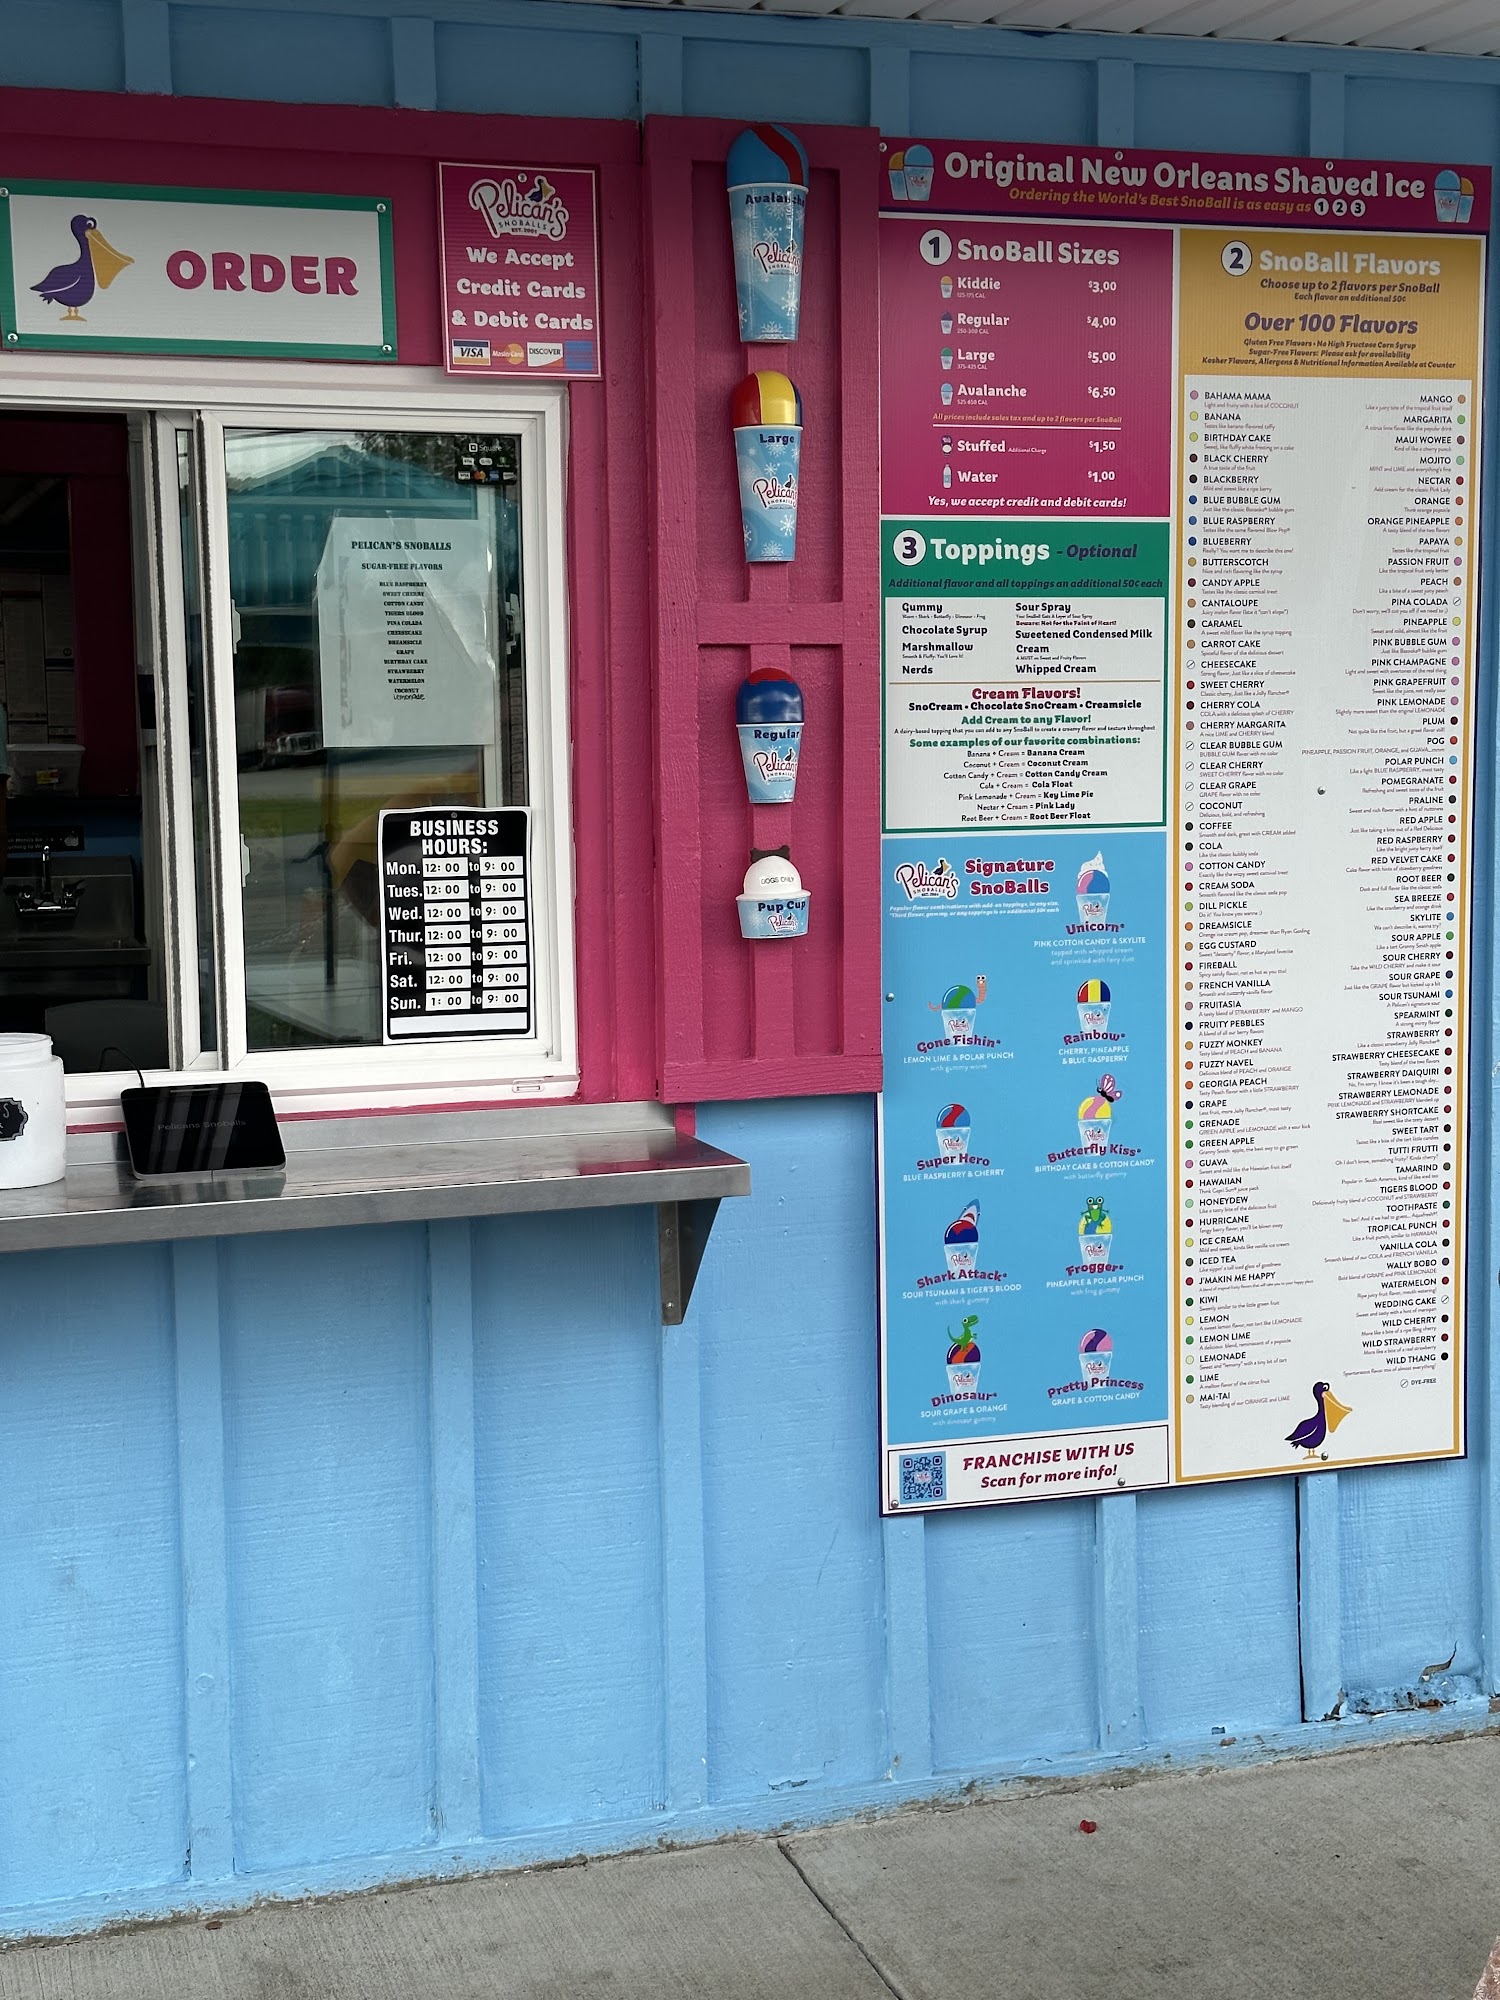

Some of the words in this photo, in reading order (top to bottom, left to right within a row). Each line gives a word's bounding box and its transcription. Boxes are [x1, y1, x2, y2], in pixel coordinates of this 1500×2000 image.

[945, 152, 1074, 187] Original
[1081, 158, 1146, 186] New
[1154, 162, 1268, 192] Orleans
[1274, 167, 1378, 197] Shaved
[1385, 173, 1425, 198] Ice
[1009, 188, 1070, 204] Ordering
[1073, 190, 1095, 202] the
[1098, 192, 1147, 205] World's
[1150, 194, 1178, 206] Best
[1180, 196, 1231, 208] SnoBall
[1233, 201, 1244, 209] is
[1247, 201, 1261, 210] as
[1264, 202, 1294, 214] easy
[1296, 204, 1311, 212] as
[1318, 202, 1326, 212] 1
[1336, 202, 1344, 213] 2
[1354, 203, 1362, 213] 3
[470, 179, 569, 239] Pelican's
[499, 220, 547, 231] SNOBALLS
[929, 236, 940, 258] 1
[958, 239, 1053, 263] SnoBall
[1058, 242, 1119, 265] Sizes
[466, 247, 497, 263] We
[505, 249, 574, 270] Accept
[1229, 248, 1243, 269] 2
[1260, 250, 1348, 273] SnoBall
[1354, 253, 1440, 276] Flavors
[166, 250, 359, 296] ORDER
[457, 278, 520, 296] Credit
[527, 281, 585, 298] Cards
[958, 277, 1000, 289] Kiddie
[1089, 281, 1116, 293] $3.00
[1261, 278, 1300, 289] Choose
[1302, 282, 1316, 292] up
[1318, 281, 1329, 290] to
[1331, 281, 1337, 290] 2
[1339, 280, 1377, 292] flavors
[1379, 284, 1397, 294] per
[1399, 283, 1440, 293] SnoBall
[1295, 292, 1312, 300] Each
[1314, 293, 1338, 302] flavor
[1350, 294, 1391, 302] additional
[452, 310, 467, 326] &
[474, 311, 528, 328] Debit
[535, 313, 593, 330] Cards
[958, 313, 1009, 327] Regular
[1087, 316, 1116, 328] $4.00
[1245, 312, 1295, 331] Over
[1299, 314, 1335, 332] 100
[1340, 314, 1418, 334] Flavors
[460, 347, 484, 357] VISA
[529, 348, 561, 356] DISCOVER
[958, 349, 995, 363] Large
[1088, 351, 1116, 363] $5.00
[958, 384, 1026, 397] Avalanche
[1088, 386, 1115, 398] $6.50
[1205, 392, 1242, 400] BAHAMA
[759, 434, 795, 445] Large
[958, 440, 1005, 452] Stuffed
[1089, 441, 1115, 452] $1.50
[958, 471, 998, 482] Water
[1088, 471, 1115, 482] $1.00
[929, 496, 948, 507] Yes,
[968, 498, 1005, 508] accept
[1007, 497, 1039, 506] credit
[1041, 497, 1062, 506] and
[1064, 497, 1092, 507] debit
[1093, 498, 1126, 507] cards!
[352, 541, 401, 549] PELICAN'S
[404, 542, 451, 550] SNOBALLS
[902, 537, 917, 559] 3
[930, 538, 1049, 565] Toppings
[1067, 544, 1137, 561] Optional
[902, 603, 942, 613] Gummy
[1016, 603, 1039, 611] Sour
[1041, 603, 1070, 613] Spray
[902, 625, 954, 634] Chocolate
[957, 626, 987, 636] Syrup
[1016, 630, 1070, 638] Sweetened
[1073, 629, 1128, 638] Condensed
[1131, 629, 1152, 638] Milk
[903, 642, 973, 651] Marshmallow
[1016, 645, 1049, 653] Cream
[902, 665, 933, 674] Nerds
[1016, 664, 1061, 675] Whipped
[972, 688, 1019, 699] Cream
[1022, 687, 1080, 699] Flavors!
[754, 729, 799, 741] Regular
[410, 820, 498, 836] BUSINESS
[422, 838, 487, 855] HOURS:
[386, 862, 420, 875] Mon.
[469, 862, 479, 871] to
[965, 859, 1054, 876] Signature
[1397, 875, 1419, 883] ROOT
[387, 885, 422, 897] Tues.
[470, 884, 480, 893] to
[971, 879, 1049, 895] SnoBalls
[1199, 882, 1229, 890] CREAM
[388, 907, 422, 920] Wed.
[758, 903, 783, 913] Pup
[787, 901, 805, 910] Cup
[389, 930, 423, 942] Thur.
[390, 952, 412, 965] Fri.
[390, 975, 417, 988] Sat.
[390, 997, 421, 1010] Sun.
[472, 995, 482, 1004] to
[917, 1155, 956, 1171] Super
[959, 1153, 990, 1166] Hero
[1380, 1185, 1407, 1193] TIGERS
[1410, 1183, 1437, 1191] BLOOD
[1200, 1196, 1248, 1206] HONEYDEW
[1381, 1278, 1436, 1288] WATERMELON
[1200, 1296, 1217, 1304] KIWI
[1047, 1380, 1088, 1398] Pretty
[1089, 1377, 1143, 1390] Princess
[963, 1450, 1061, 1470] FRANCHISE
[1066, 1445, 1110, 1461] WITH
[1115, 1443, 1134, 1456] US
[981, 1477, 1016, 1488] Scan
[1019, 1472, 1042, 1488] for
[1044, 1471, 1081, 1482] more
[1084, 1464, 1117, 1480] info!
